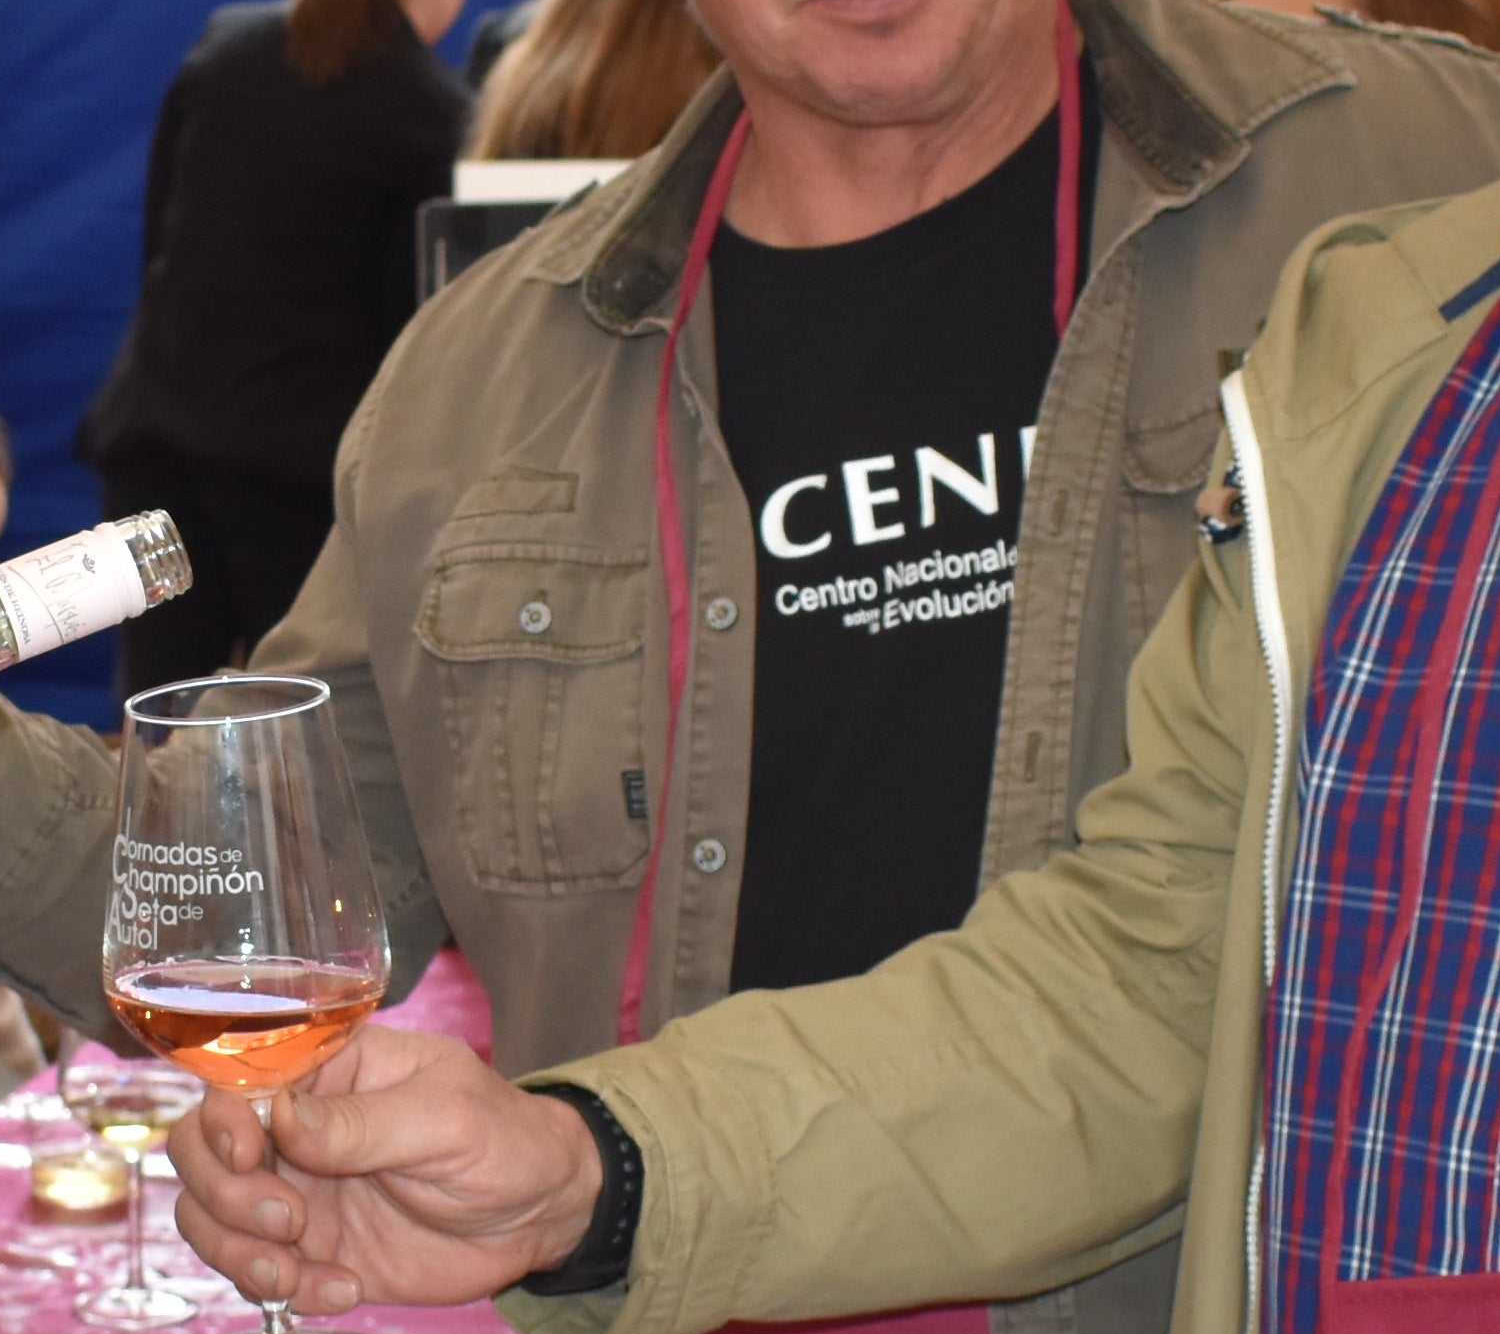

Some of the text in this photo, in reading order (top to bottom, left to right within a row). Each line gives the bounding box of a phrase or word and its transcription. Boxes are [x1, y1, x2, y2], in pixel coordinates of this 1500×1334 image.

[775, 576, 878, 615] Centro
[884, 539, 1006, 594] Nacional
[884, 579, 1015, 629] Evolución
[122, 806, 242, 866] Jornadas de
[113, 833, 264, 901] Champiñón
[105, 891, 158, 951] Autol
[121, 881, 204, 926] Seta de
